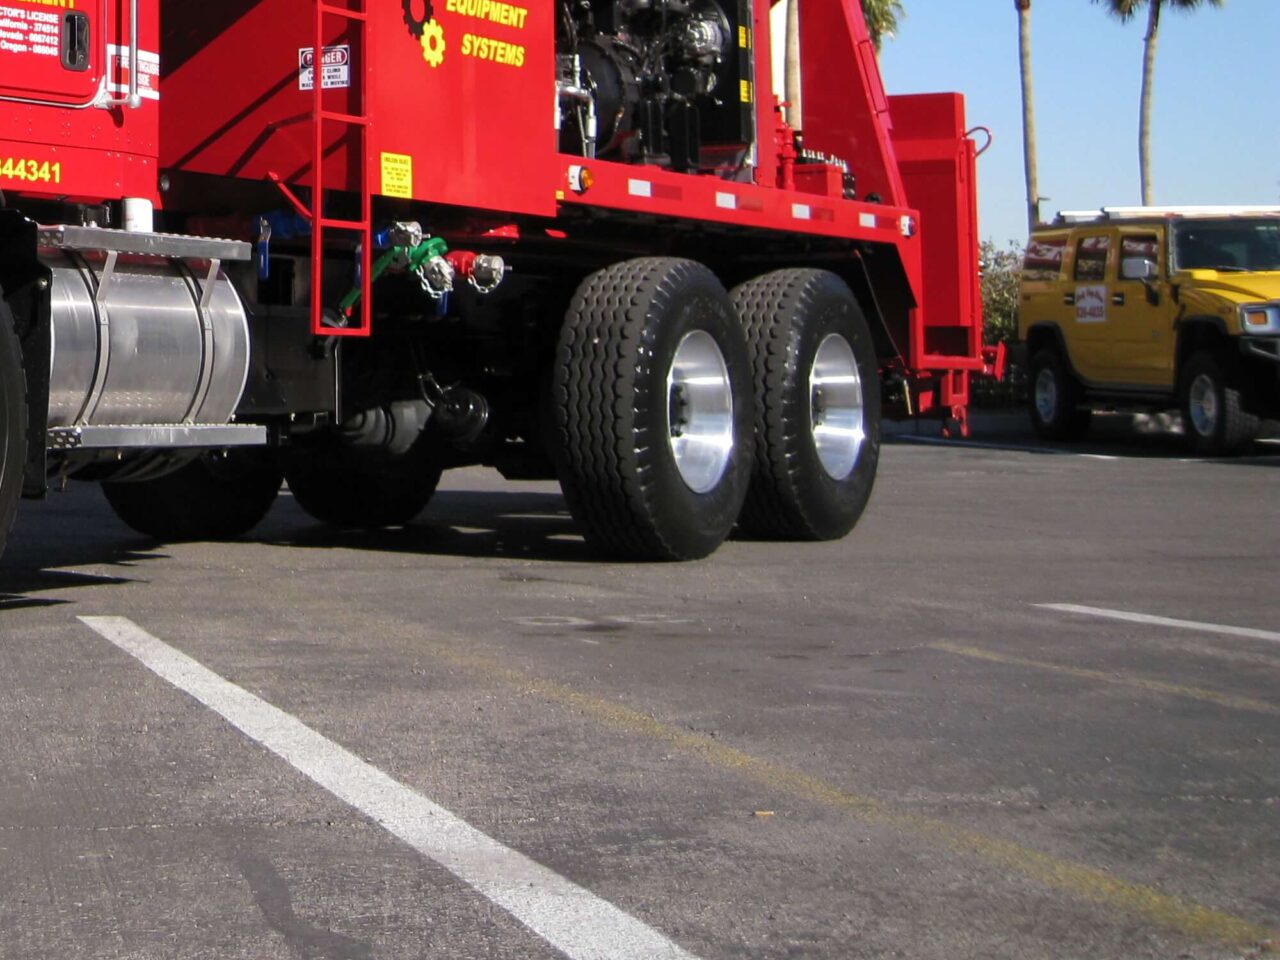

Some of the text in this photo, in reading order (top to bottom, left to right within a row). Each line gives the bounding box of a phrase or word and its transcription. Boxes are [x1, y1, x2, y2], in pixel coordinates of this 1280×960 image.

[26, 10, 59, 23] LICENSE
[306, 50, 342, 65] DGER
[461, 33, 525, 68] SYSTEMS
